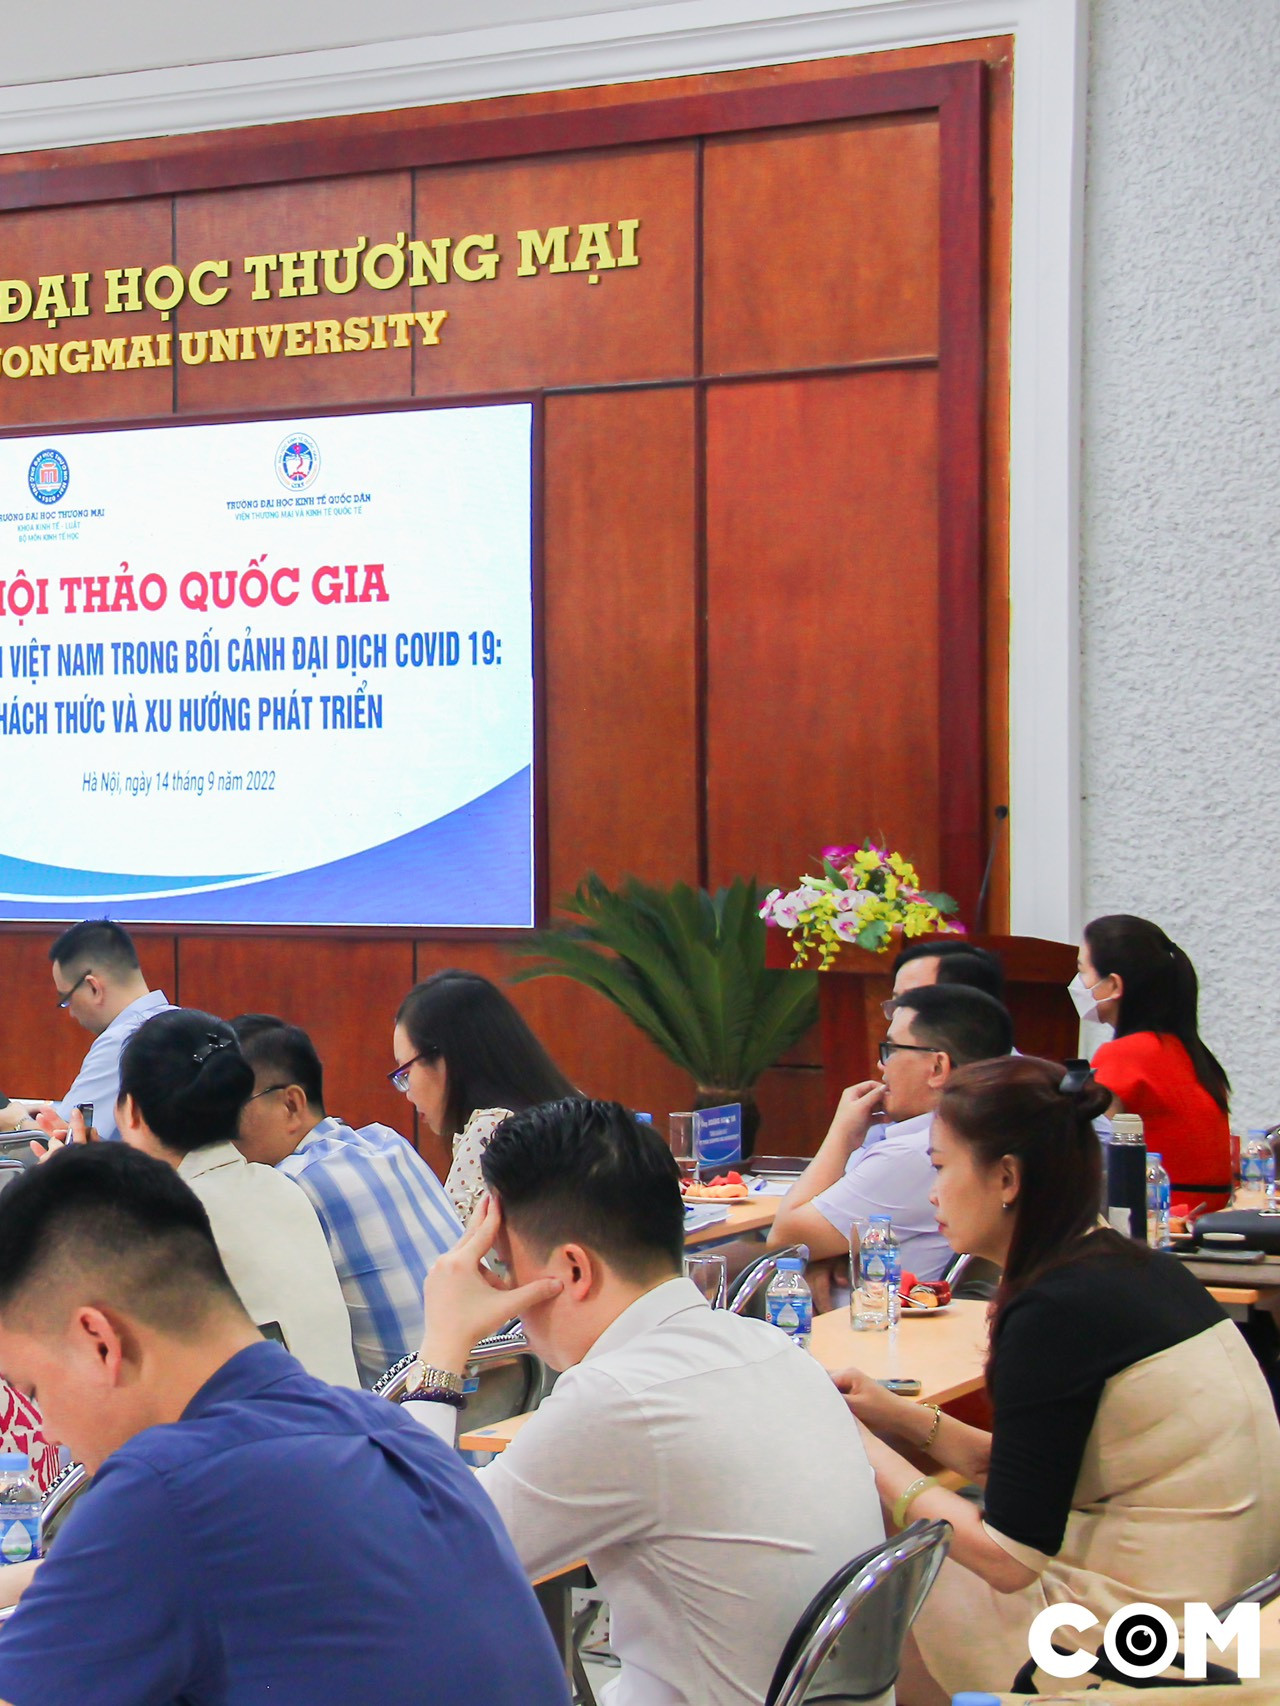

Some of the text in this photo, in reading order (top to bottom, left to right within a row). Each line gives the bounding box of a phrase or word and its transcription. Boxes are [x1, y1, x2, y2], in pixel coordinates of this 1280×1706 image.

[104, 260, 231, 321] HỌC
[243, 233, 499, 301] THƯƠNG
[516, 219, 641, 285] MẠI
[179, 310, 449, 366] UNIVERSITY
[60, 561, 168, 613] THẢO
[179, 554, 300, 613] QUỐC
[312, 563, 390, 604] GIA
[9, 638, 52, 686] VIỆT
[57, 642, 105, 677] NAM
[111, 640, 179, 675] TRONG
[186, 627, 220, 674] BỐI
[227, 625, 286, 673] CẢNH
[292, 635, 329, 677] ĐẠI
[336, 634, 388, 677] DỊCH
[395, 630, 460, 668] COVID
[467, 630, 503, 667] 19:
[55, 693, 106, 735] THỨC
[113, 692, 138, 735] VÀ
[145, 699, 173, 734] XU
[179, 691, 251, 733] HƯỚNG
[259, 689, 315, 731] PHÁT
[321, 679, 383, 730] TRIỂN
[82, 770, 275, 797] Hà Nội, ngày 14 tháng 9 năm 2022
